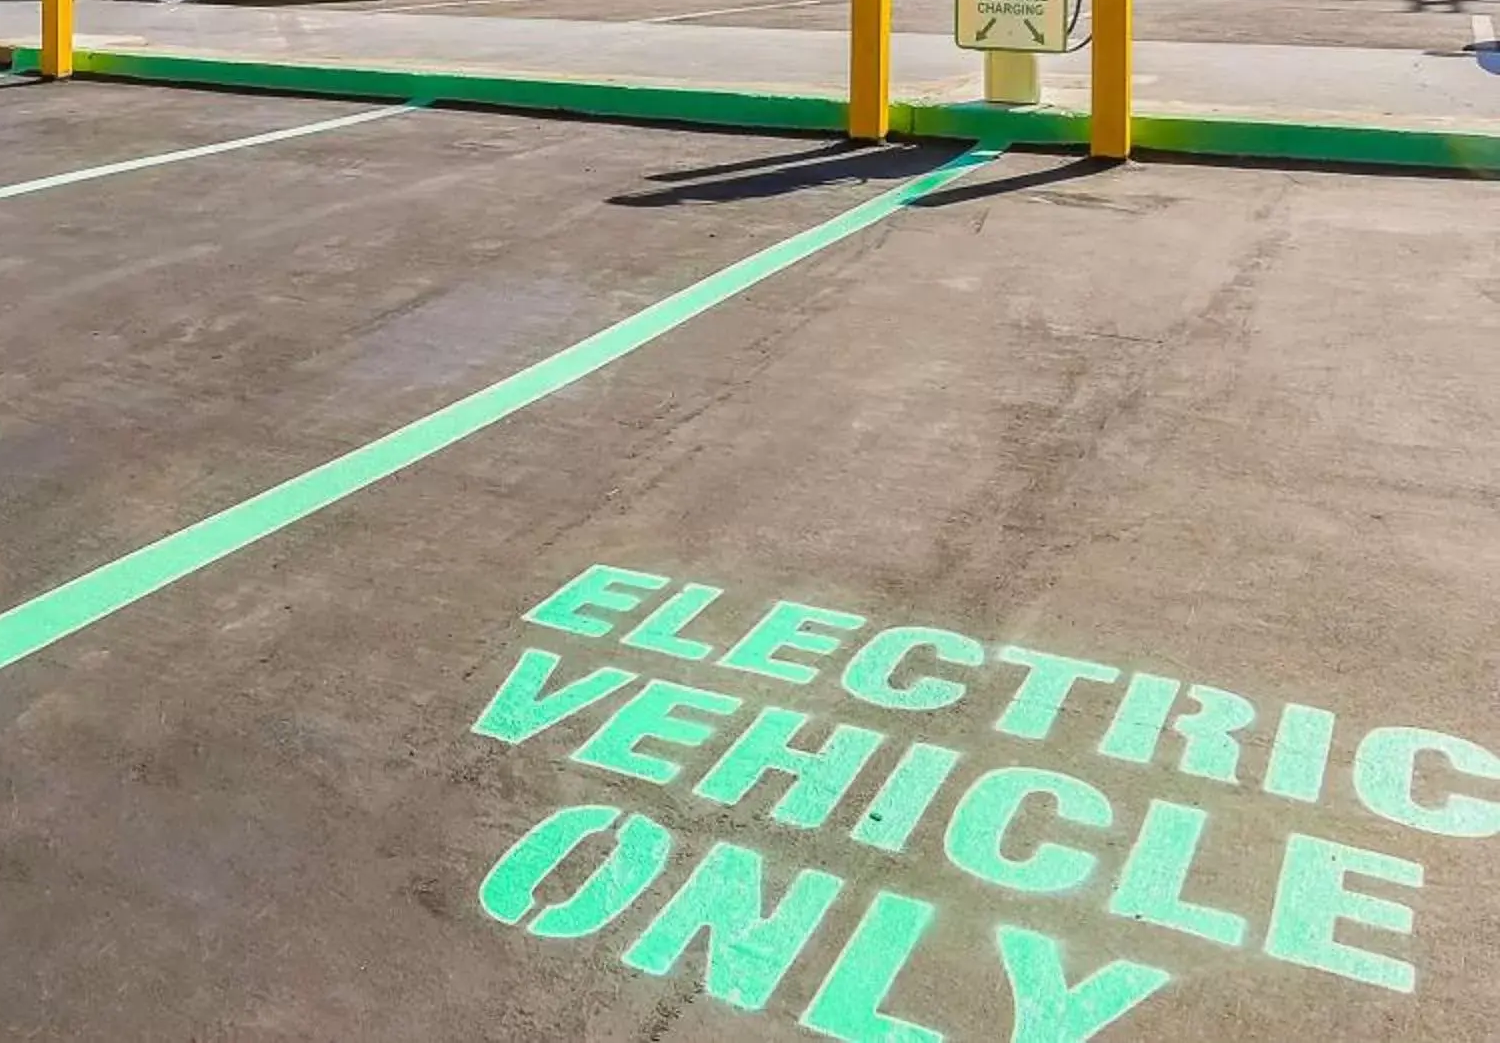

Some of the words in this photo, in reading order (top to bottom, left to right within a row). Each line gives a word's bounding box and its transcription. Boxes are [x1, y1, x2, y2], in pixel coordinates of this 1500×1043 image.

[977, 2, 1044, 16] CHARGING
[470, 648, 1426, 994] VEHICLE
[521, 564, 1500, 837] ELECTRIC
[478, 805, 1171, 1043] ONLY
